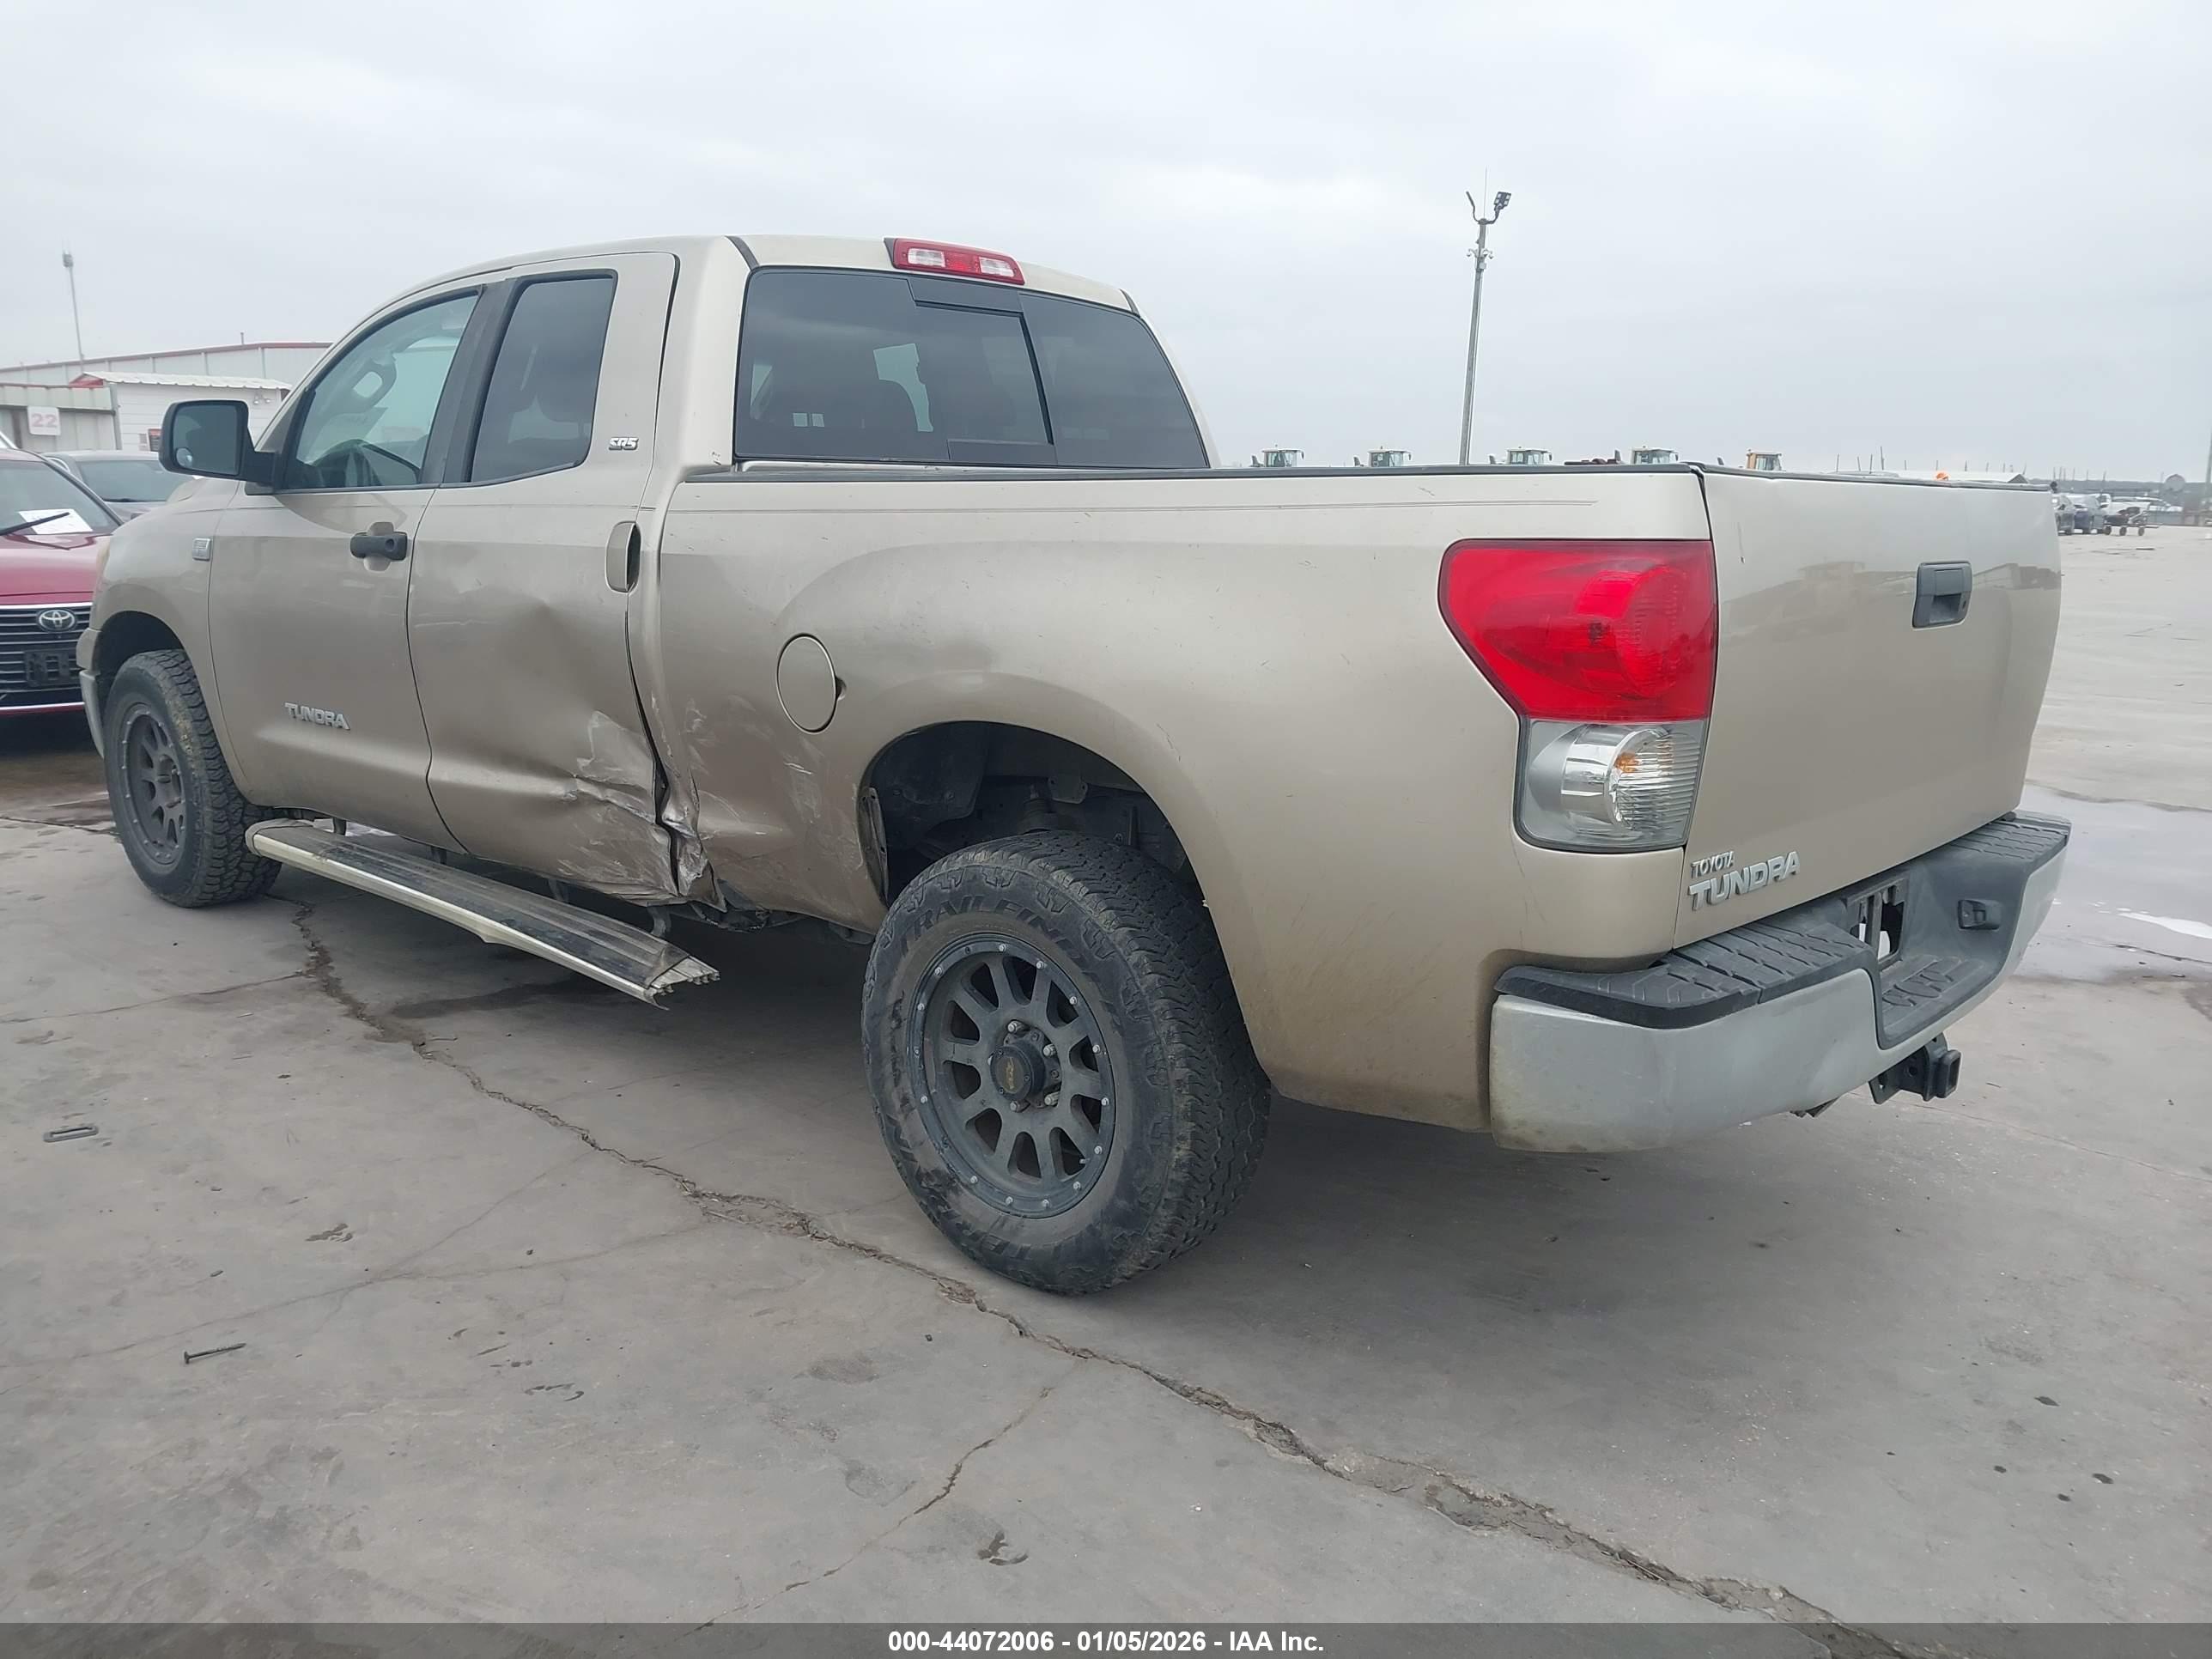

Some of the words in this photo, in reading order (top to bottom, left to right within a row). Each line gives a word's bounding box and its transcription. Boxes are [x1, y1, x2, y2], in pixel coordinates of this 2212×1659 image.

[31, 413, 58, 428] 22
[284, 702, 351, 731] TUNDRA
[1688, 851, 1801, 911] TUNDRA
